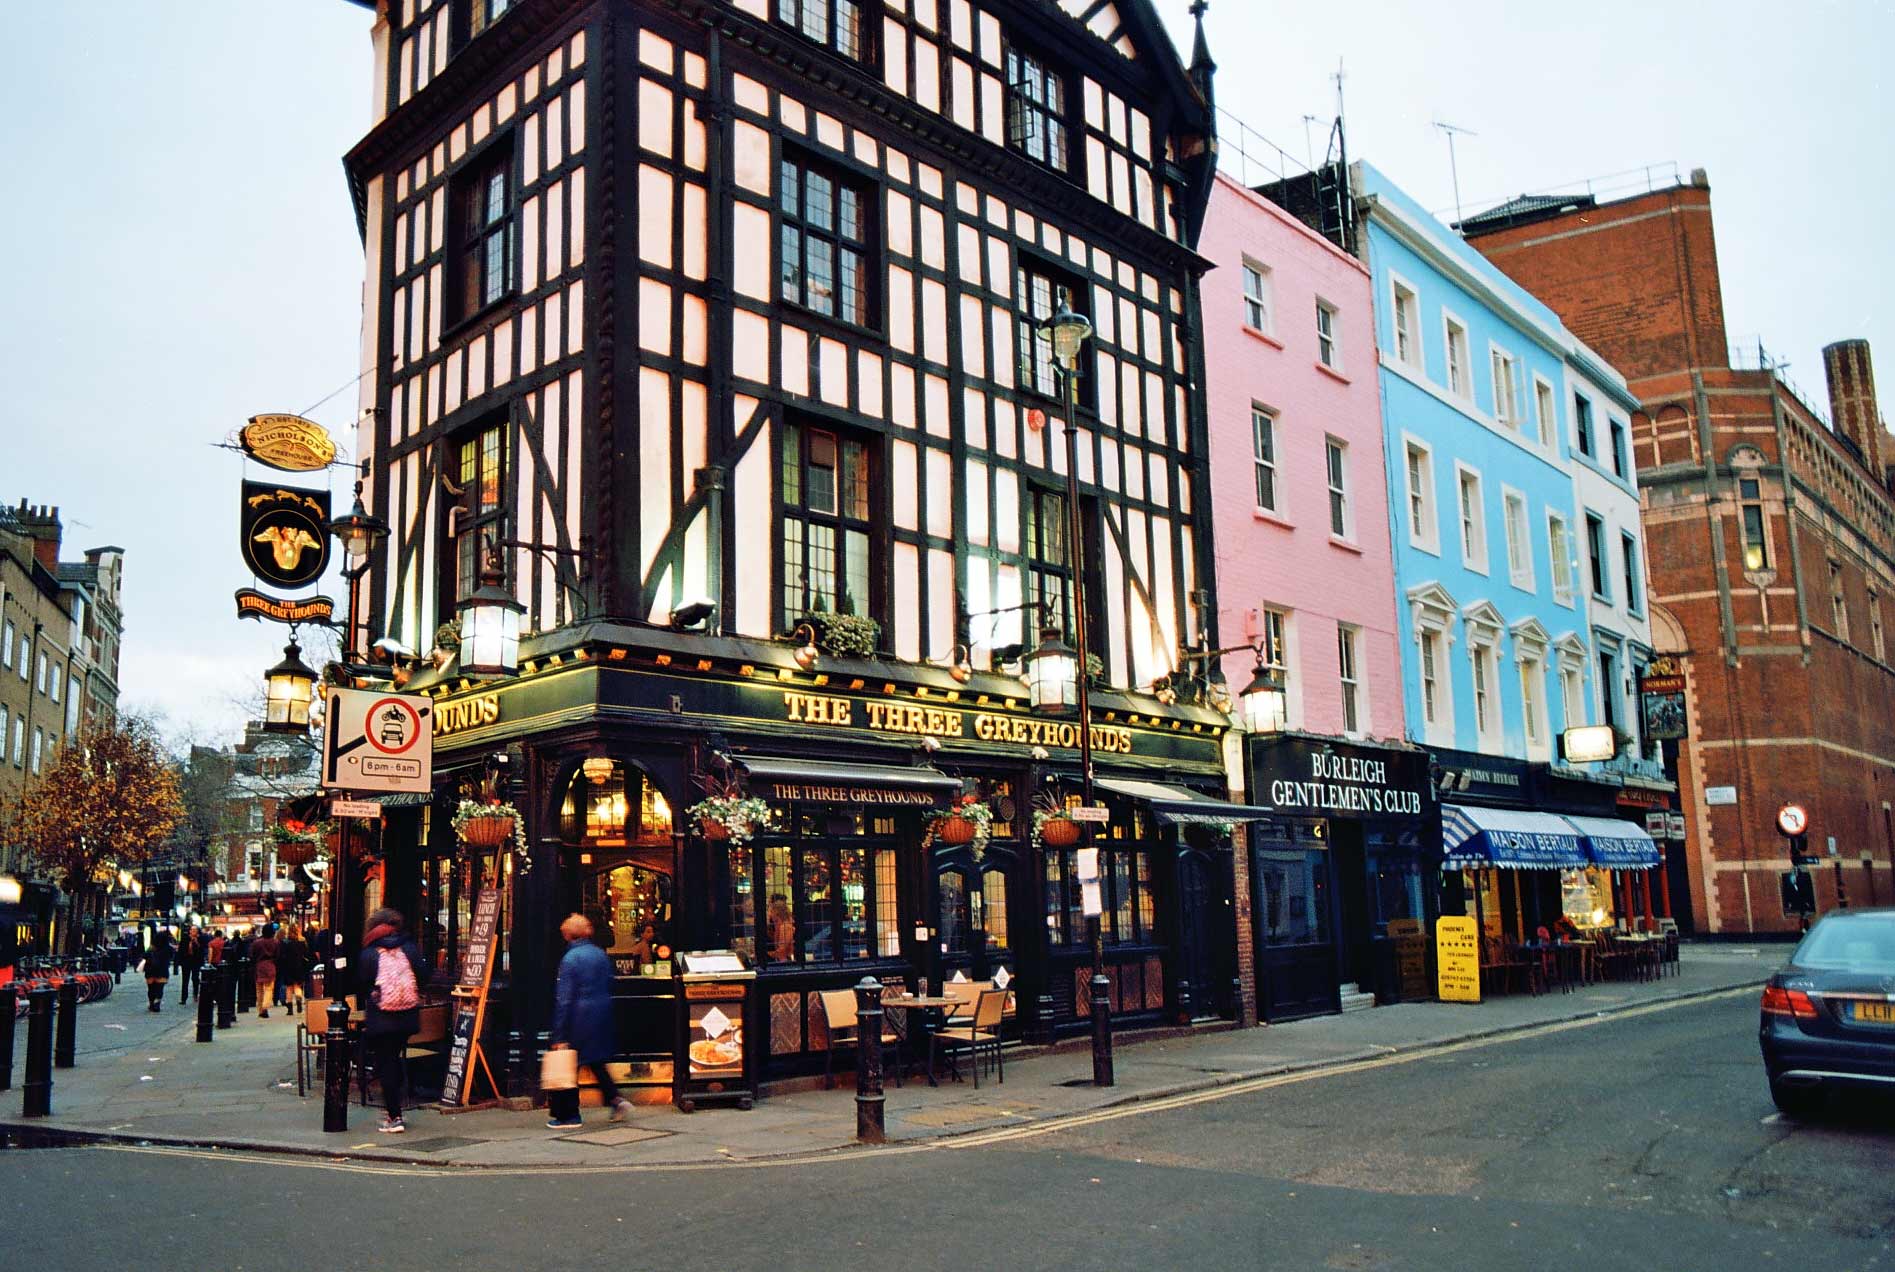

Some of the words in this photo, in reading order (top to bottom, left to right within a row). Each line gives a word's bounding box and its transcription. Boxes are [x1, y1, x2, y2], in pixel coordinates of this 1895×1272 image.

[257, 431, 328, 457] NICHOLSON'S
[239, 595, 271, 614] THREE
[270, 603, 332, 619] GREYHOUNDS
[279, 600, 297, 609] THE
[782, 692, 852, 725] THE
[865, 701, 963, 738] THREE
[1311, 753, 1387, 784] BURLEIGH
[773, 783, 801, 800] THE
[802, 785, 848, 802] THREE
[849, 788, 935, 806] GREYHOUNDS
[1271, 779, 1382, 813] GENTLEMEN'S
[1383, 788, 1421, 815] CLUB
[1489, 831, 1535, 850] MAISON
[1535, 833, 1579, 852] BERTAUX
[1590, 836, 1625, 852] MAISON
[1625, 838, 1657, 853] BERTAUX
